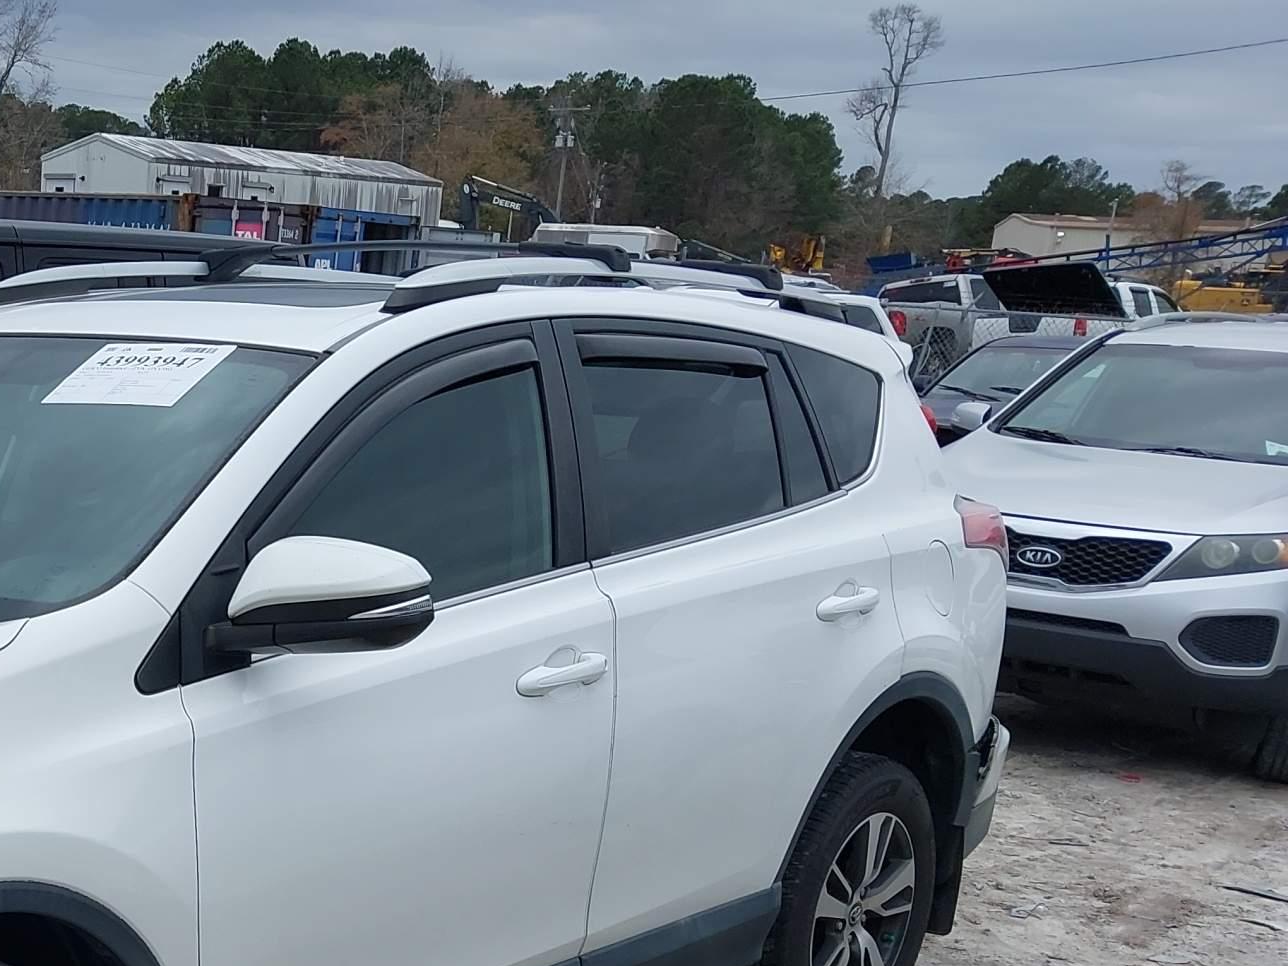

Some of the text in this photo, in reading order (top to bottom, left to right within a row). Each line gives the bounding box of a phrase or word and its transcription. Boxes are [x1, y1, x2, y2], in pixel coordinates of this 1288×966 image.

[492, 196, 522, 211] DEERE
[96, 355, 206, 368] 43993947
[1025, 550, 1052, 563] KIA
